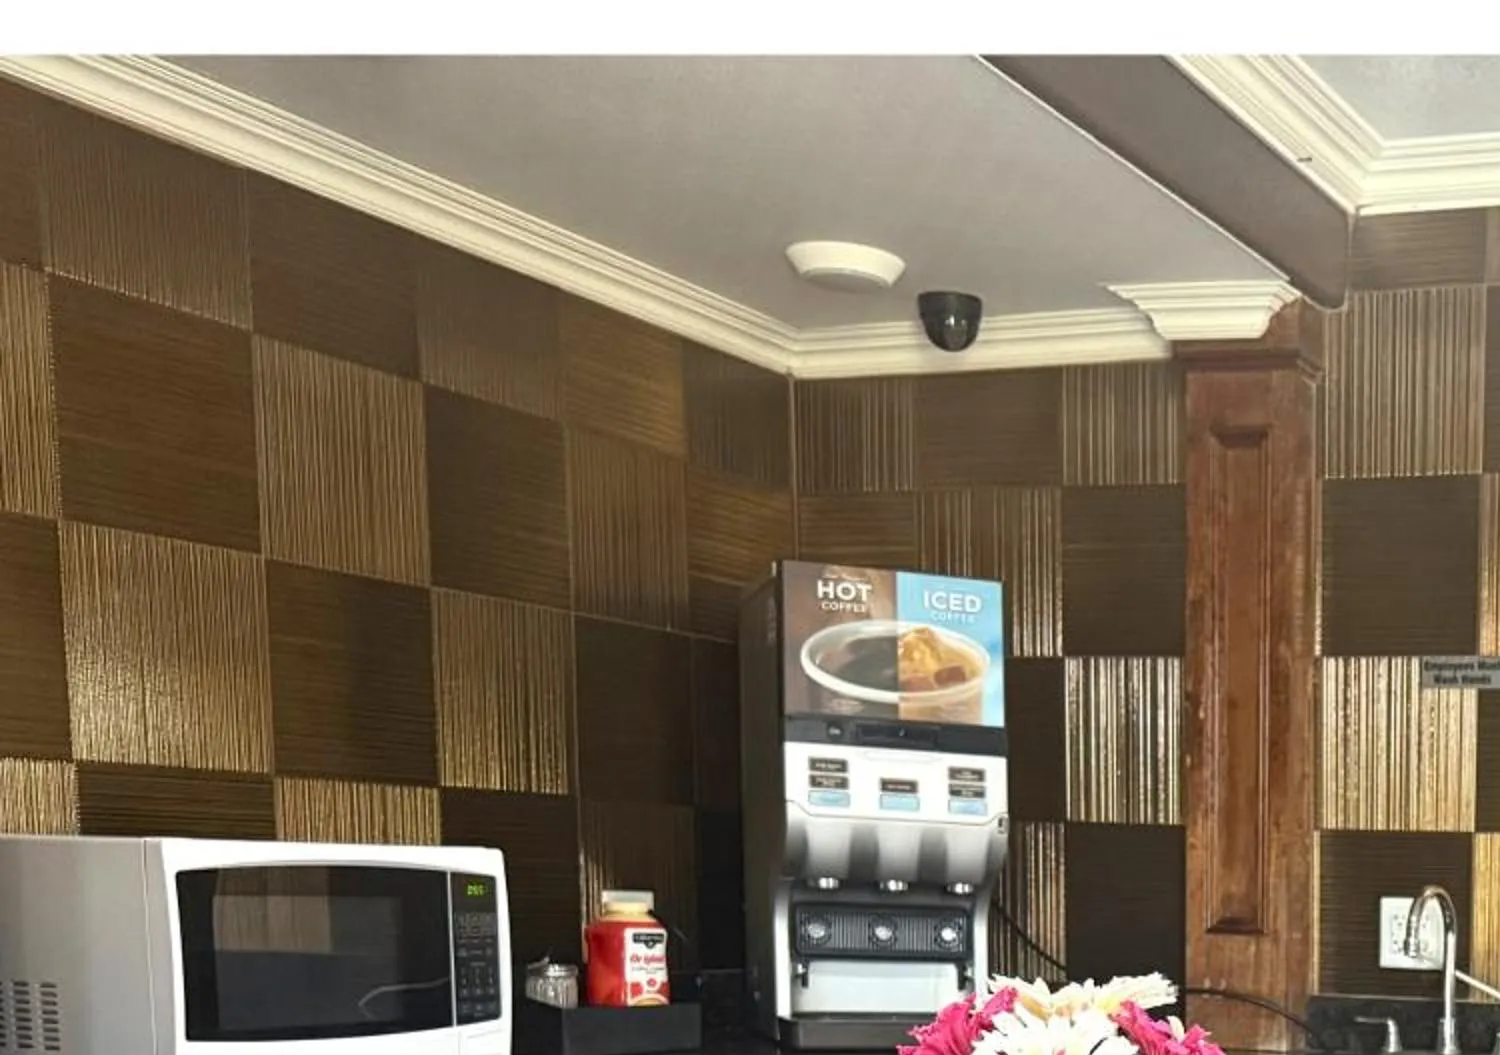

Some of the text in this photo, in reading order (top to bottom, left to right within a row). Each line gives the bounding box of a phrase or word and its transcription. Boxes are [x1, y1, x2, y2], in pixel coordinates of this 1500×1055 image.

[817, 579, 872, 601] HOT
[821, 601, 867, 613] COFFEE
[923, 590, 982, 613] ICED
